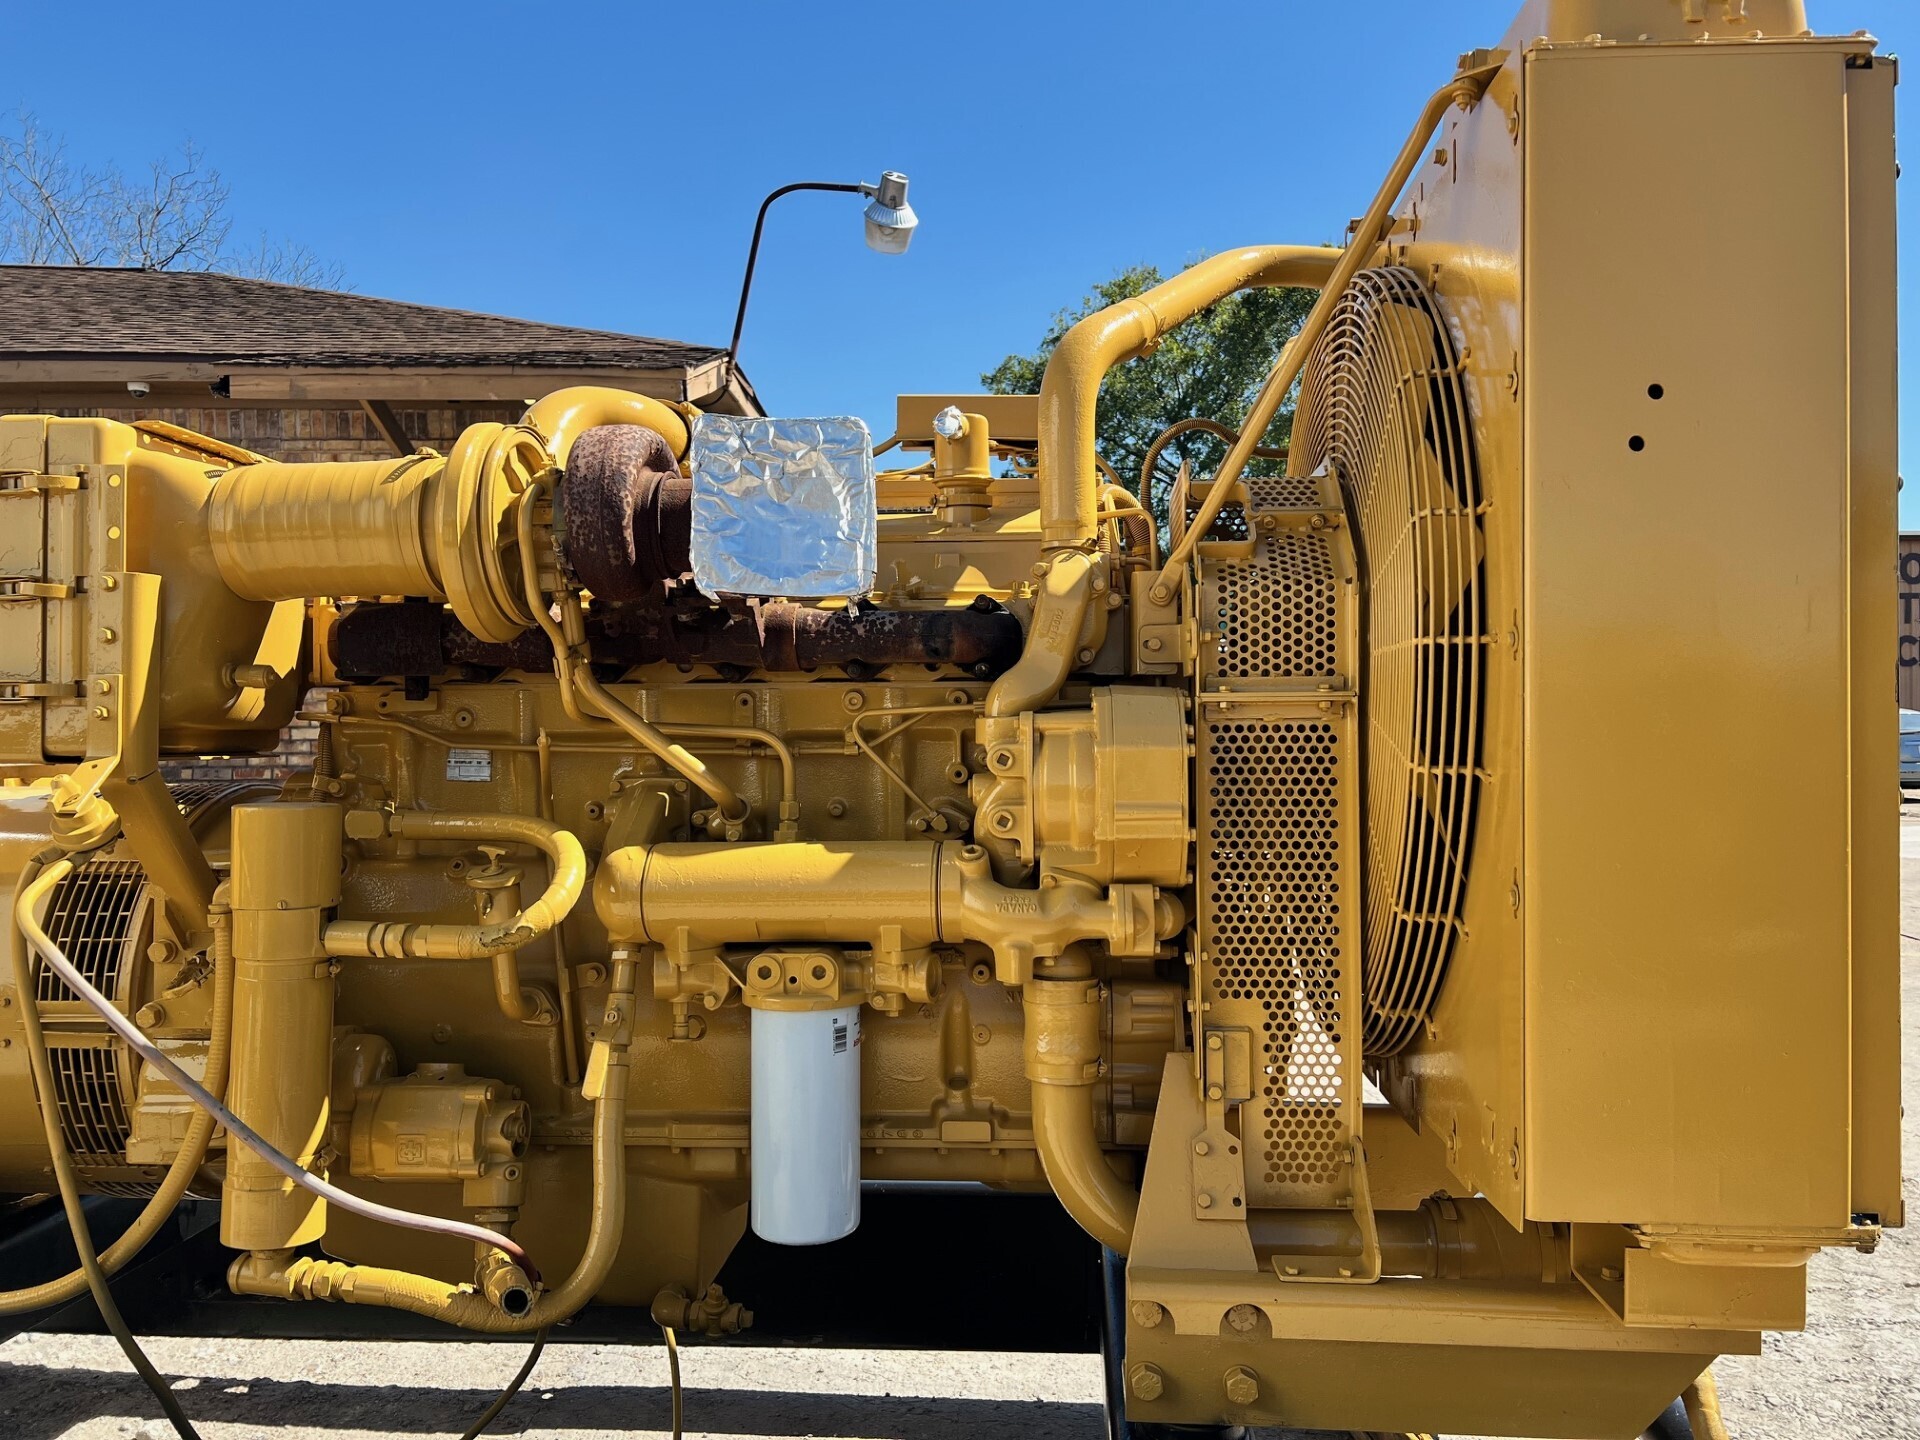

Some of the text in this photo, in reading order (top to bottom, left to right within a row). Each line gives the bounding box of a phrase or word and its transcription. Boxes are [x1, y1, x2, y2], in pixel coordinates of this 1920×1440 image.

[1899, 553, 1920, 585] O
[1899, 593, 1920, 625] T
[1899, 635, 1920, 667] C
[994, 903, 1037, 914] CANADA
